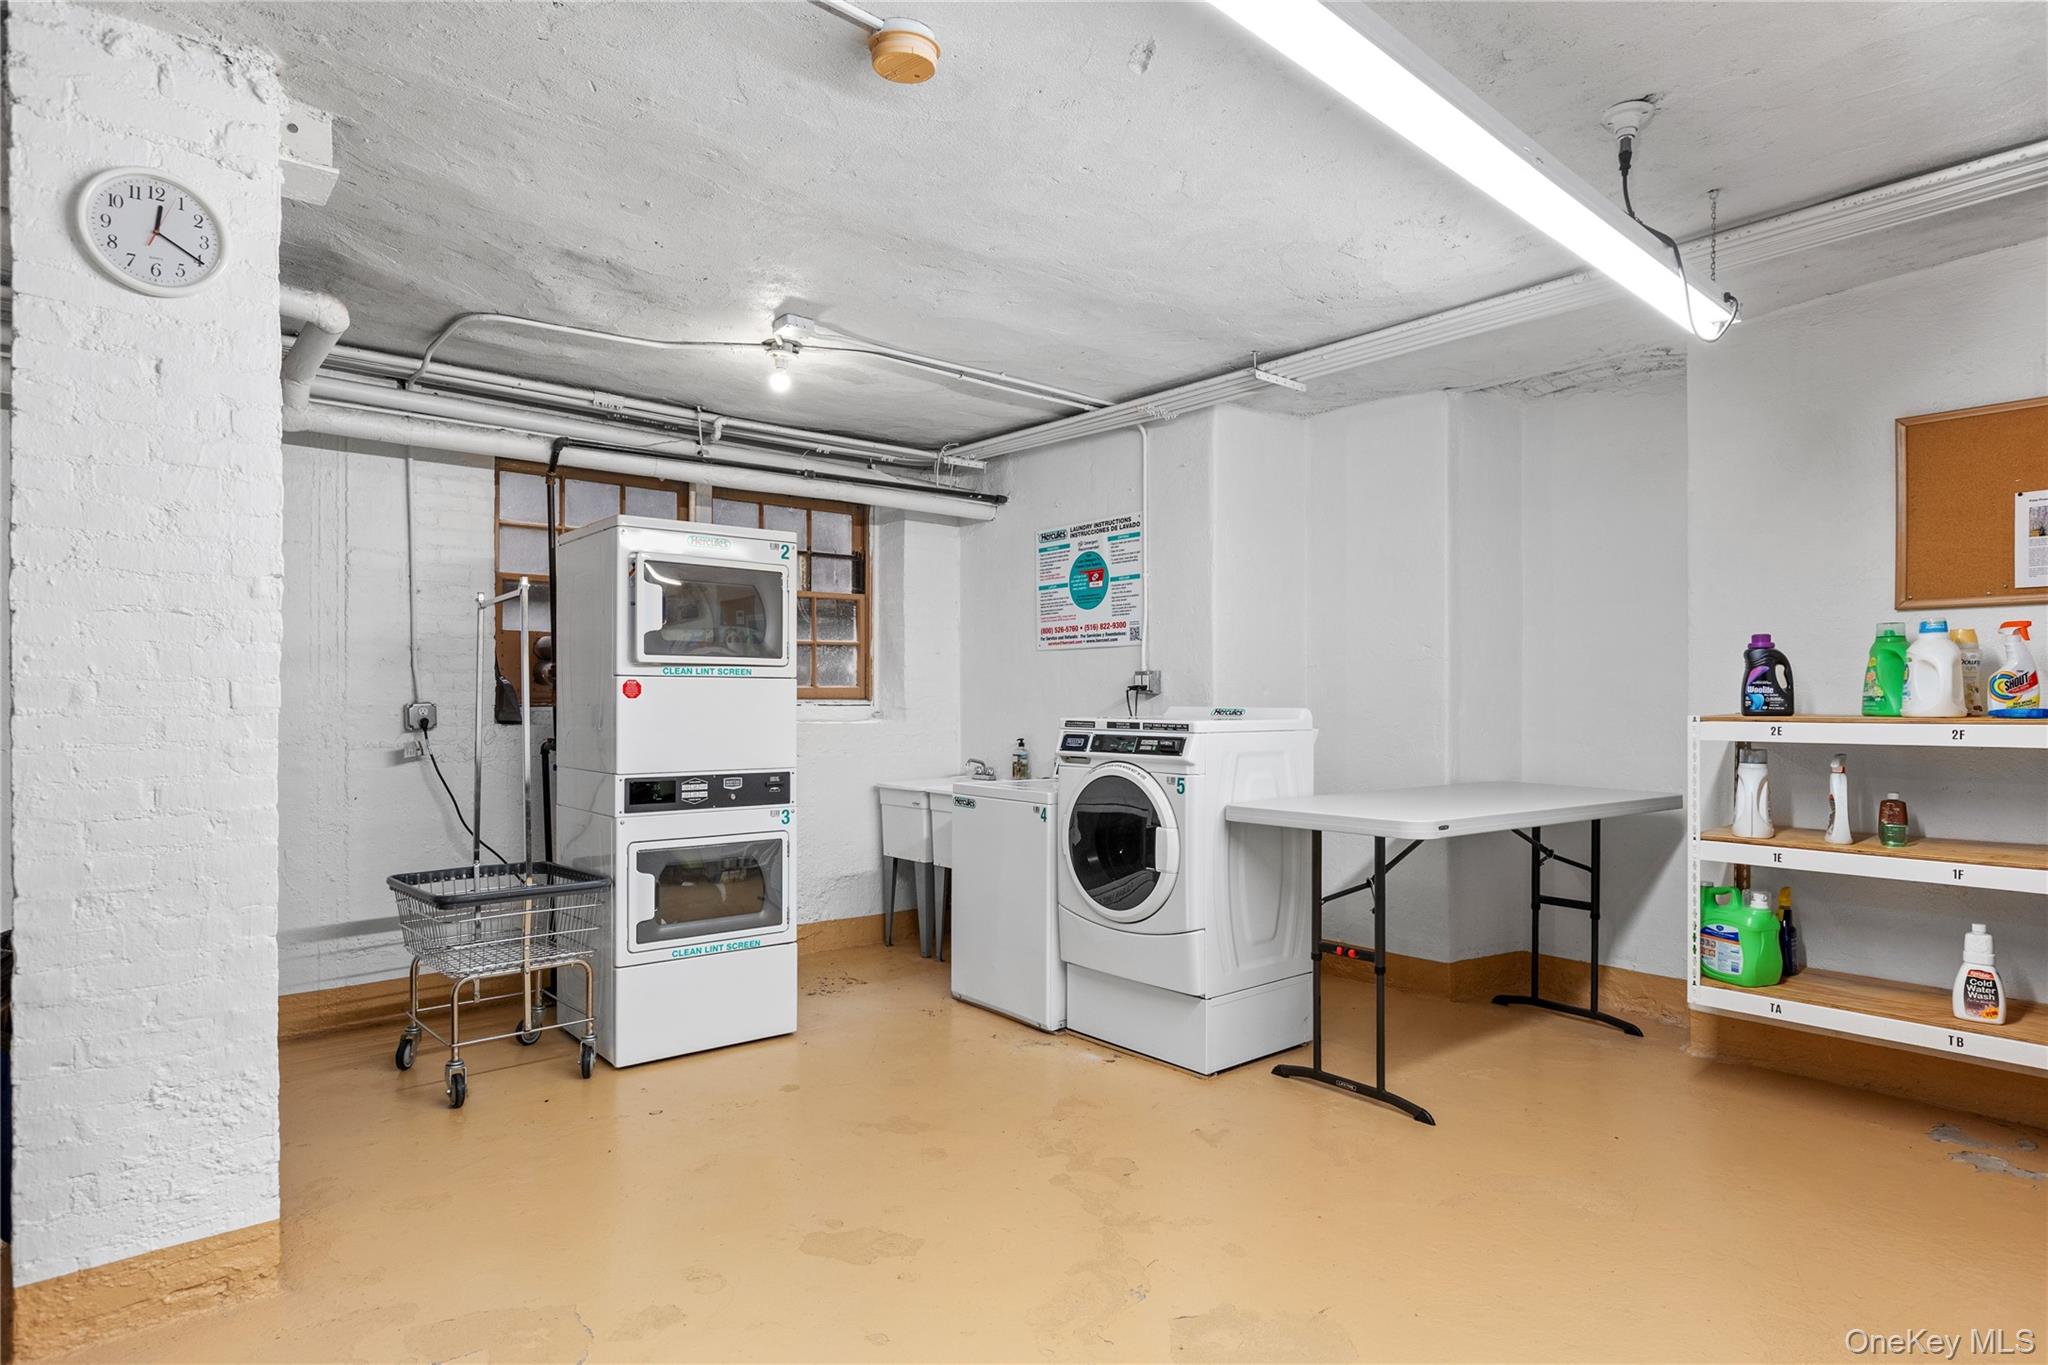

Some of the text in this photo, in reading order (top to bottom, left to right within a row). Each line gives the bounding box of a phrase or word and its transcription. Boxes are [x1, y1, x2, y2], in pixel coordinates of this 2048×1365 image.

[129, 185, 141, 200] 11
[149, 185, 166, 202] 12
[108, 193, 124, 208] 10
[178, 197, 184, 211] 1
[100, 213, 112, 228] 9
[193, 214, 204, 229] 2
[107, 234, 118, 249] 8
[199, 236, 210, 250] 3
[126, 252, 136, 267] 7
[150, 263, 162, 277] 6
[175, 263, 186, 277] 5
[1069, 516, 1132, 533] LAUNDRY INSTRUCTIONS
[1069, 527, 1110, 539] INSTRUCCIONES
[1119, 521, 1140, 530] LAVADO
[1040, 530, 1067, 542] Hercules
[780, 544, 790, 560] 2
[1040, 627, 1054, 636] (800)
[1084, 623, 1099, 632] (516)
[1100, 620, 1127, 630] 822-9300
[662, 666, 752, 676] CLEAN LINT SCREEN
[2004, 671, 2029, 691] SHOUT
[1213, 708, 1243, 716] Hercules
[1770, 726, 1783, 737] 2E
[1951, 729, 1966, 741] 2F
[1176, 777, 1185, 794] 5
[781, 809, 790, 824] 3
[1040, 807, 1047, 822] 4
[1773, 852, 1783, 863] 1E
[1953, 869, 1965, 880] 1F
[671, 939, 761, 958] CLEAN LINT SCREEN
[1966, 984, 1997, 994] Water
[1969, 978, 1993, 987] Cold
[1967, 991, 1995, 1001] Wash
[1770, 1002, 1782, 1014] TA
